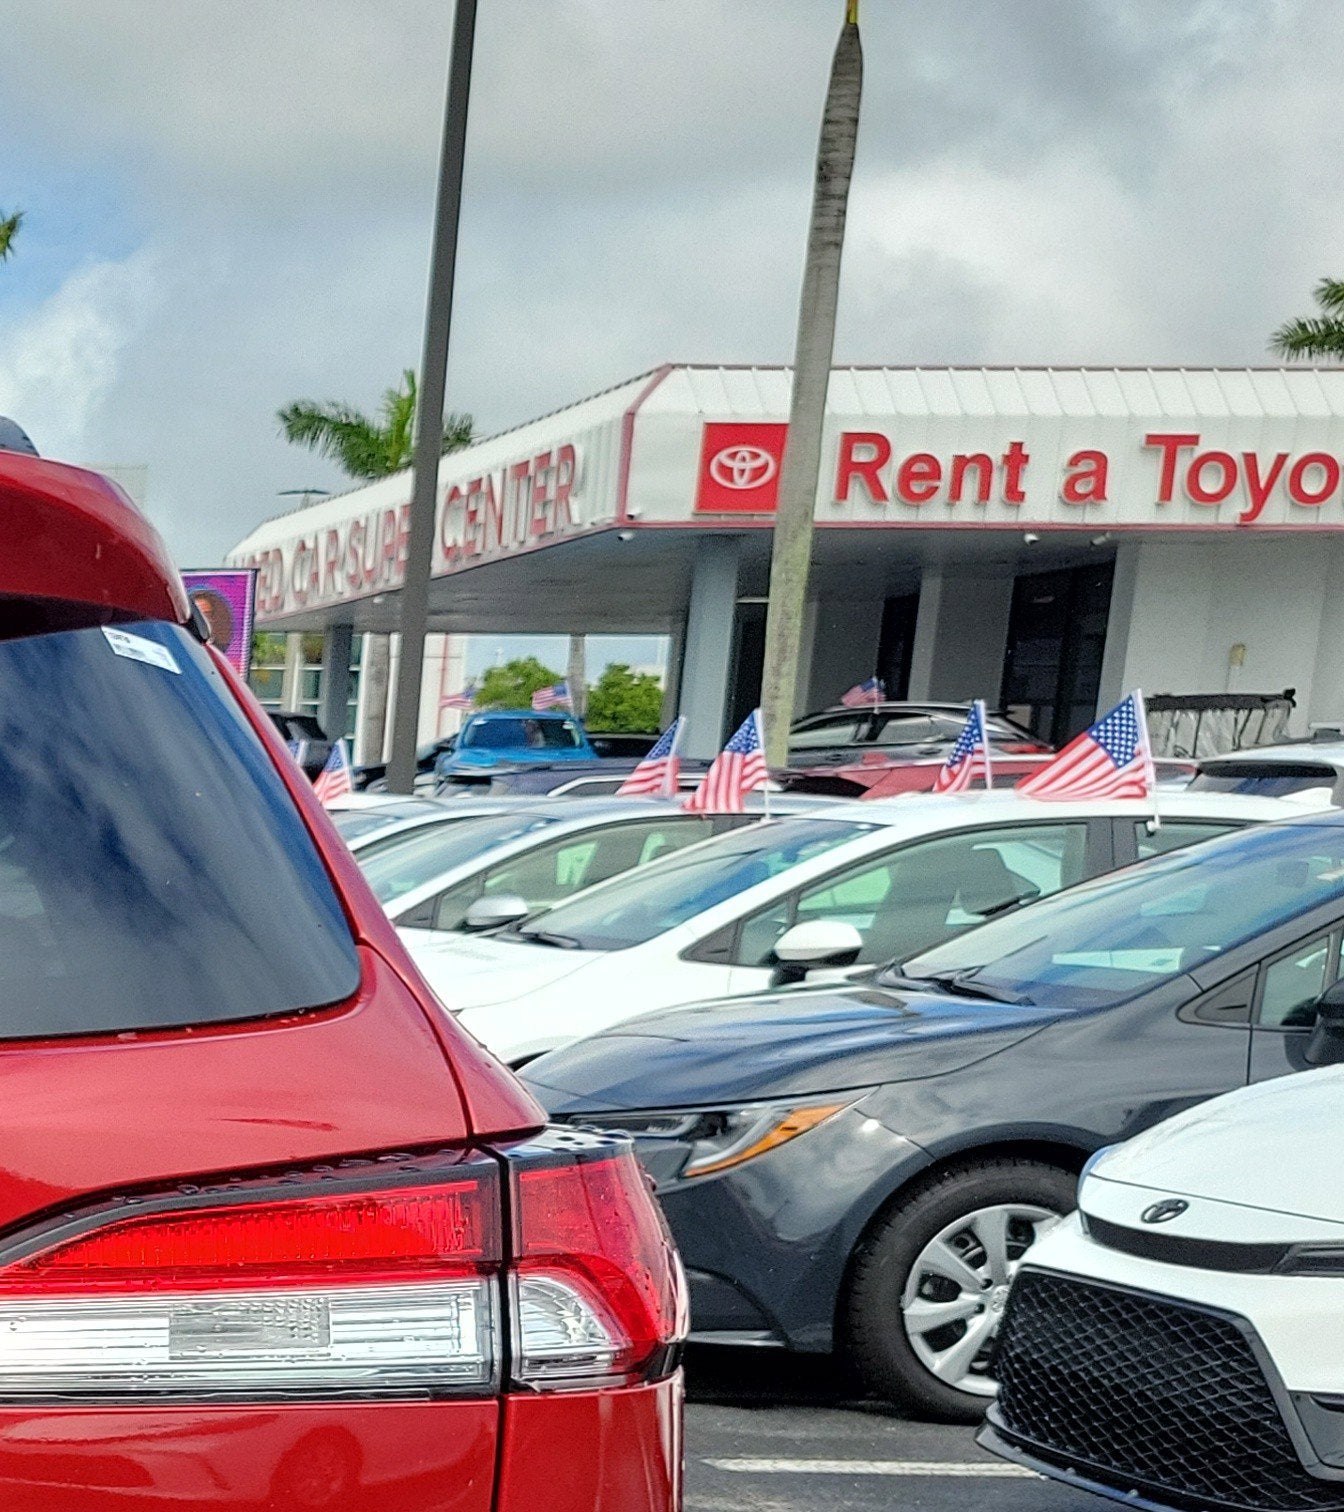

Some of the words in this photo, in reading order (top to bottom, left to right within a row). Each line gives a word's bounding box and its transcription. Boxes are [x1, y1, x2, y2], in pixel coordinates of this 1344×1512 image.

[292, 527, 345, 605] CAR
[348, 503, 411, 589] SUPE
[440, 443, 579, 563] CENTER
[835, 431, 1031, 503] Rent
[1061, 448, 1109, 503] a
[1144, 433, 1341, 524] Toyo
